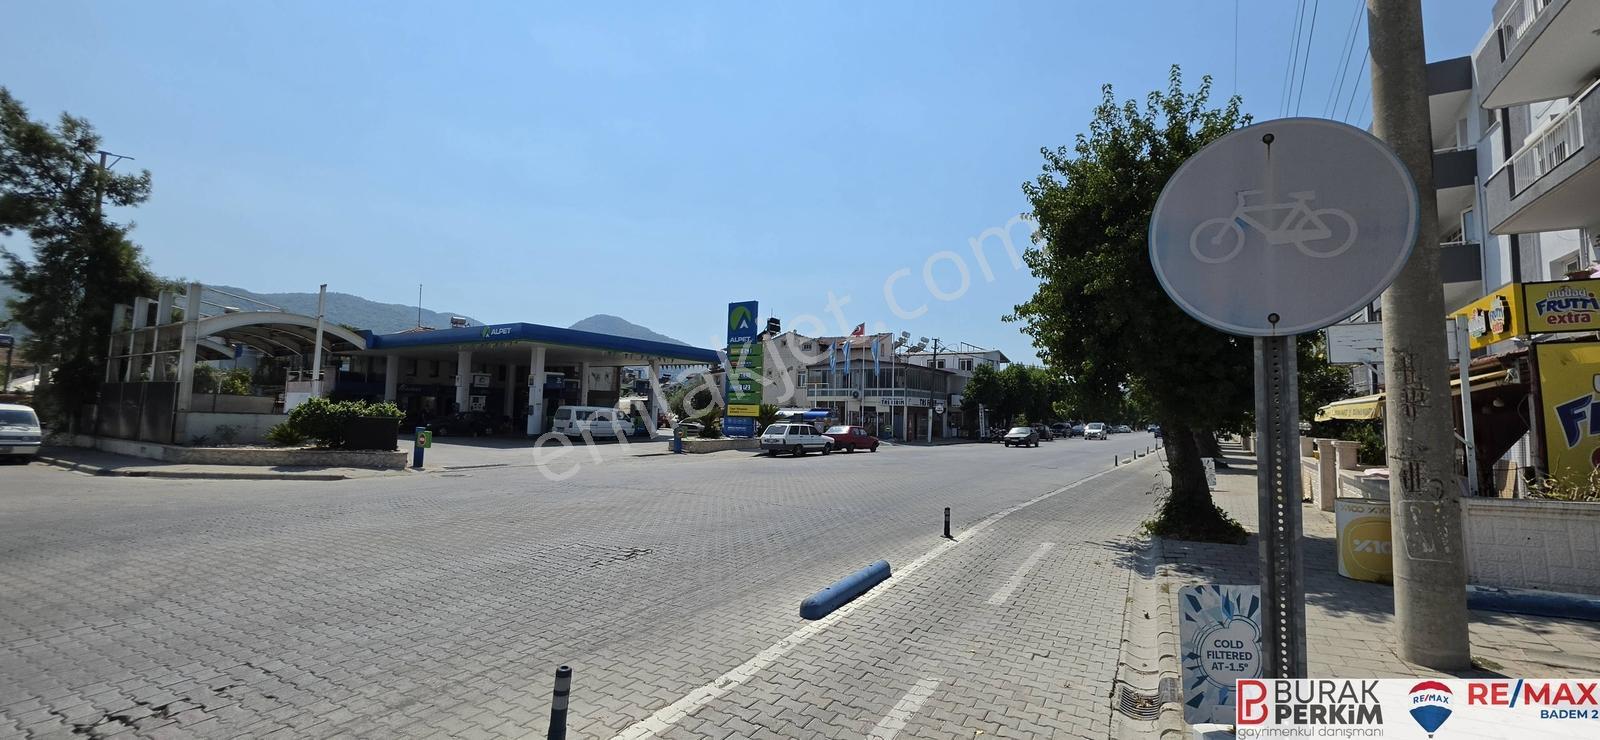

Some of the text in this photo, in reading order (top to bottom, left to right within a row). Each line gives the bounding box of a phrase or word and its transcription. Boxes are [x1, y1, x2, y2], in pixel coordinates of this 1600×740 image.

[1547, 312, 1591, 325] extra
[490, 327, 512, 336] ALPET
[729, 336, 752, 344] ALPET
[1213, 639, 1244, 649] COLD
[1206, 650, 1253, 661] FILTERED
